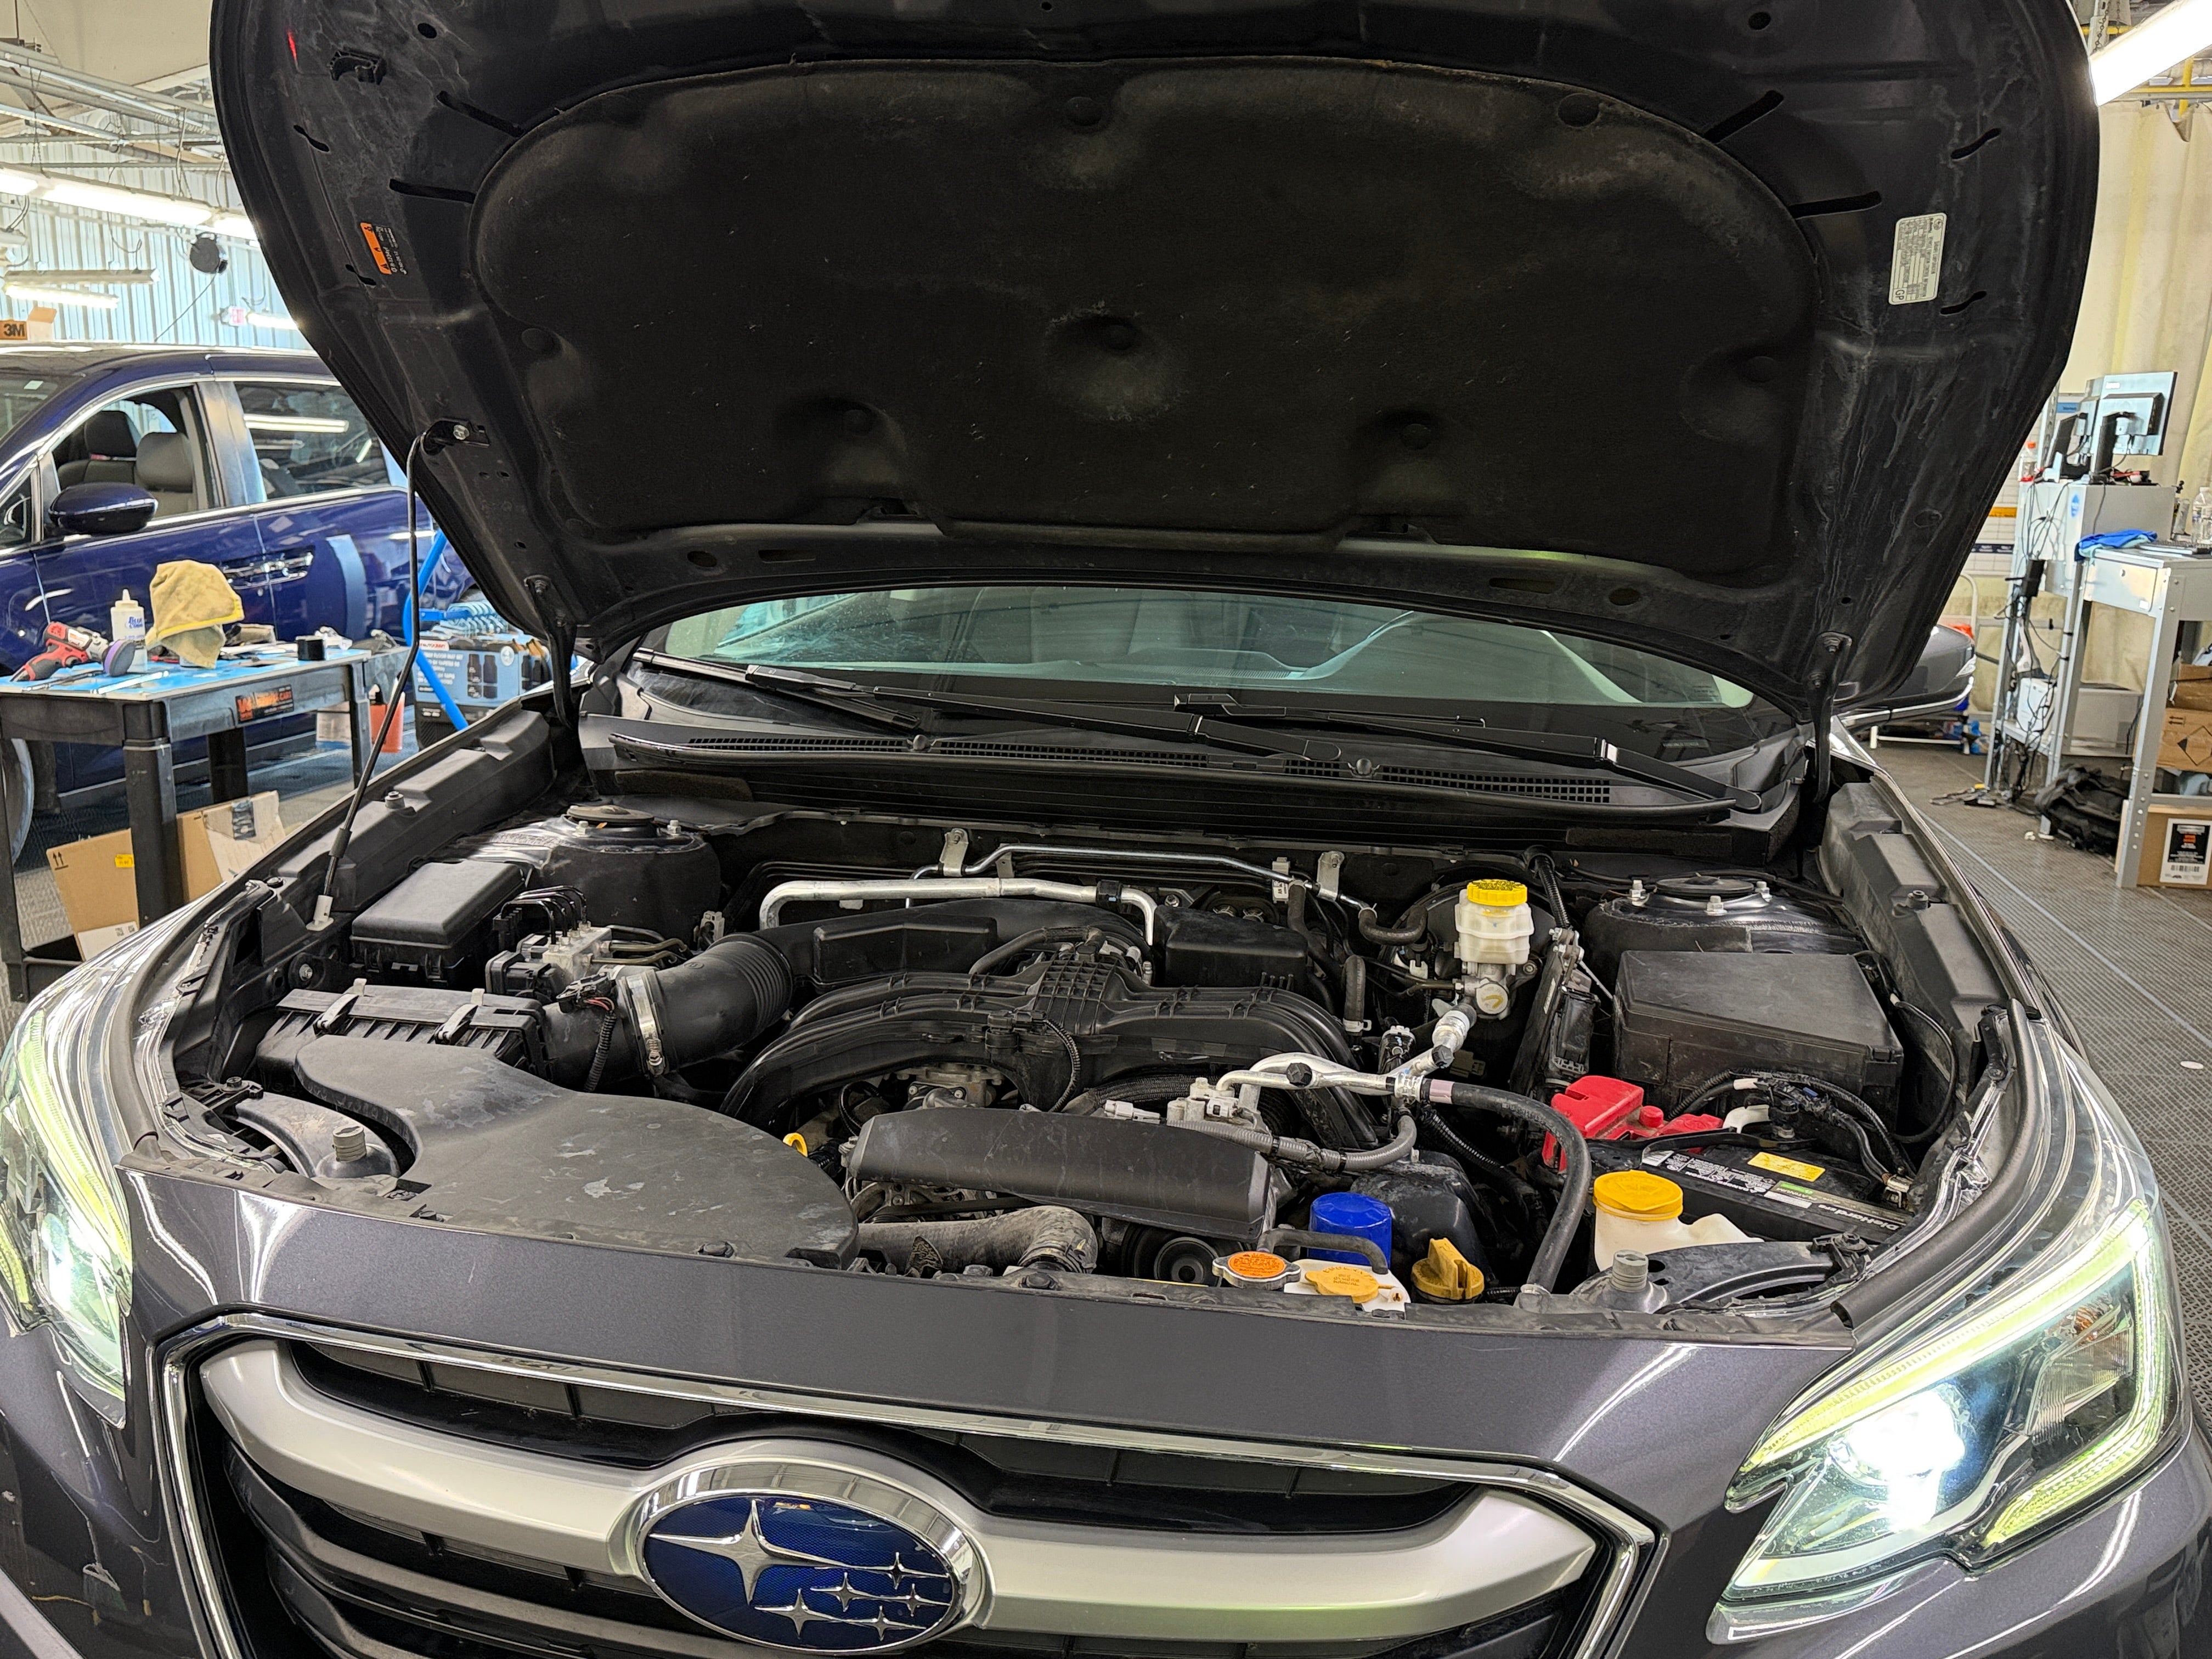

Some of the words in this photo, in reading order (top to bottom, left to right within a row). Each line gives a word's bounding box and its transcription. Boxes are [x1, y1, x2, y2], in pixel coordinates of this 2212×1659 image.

[1895, 289, 1905, 301] GP
[3, 323, 25, 337] 3M
[1834, 1209, 1900, 1231] DieHard
